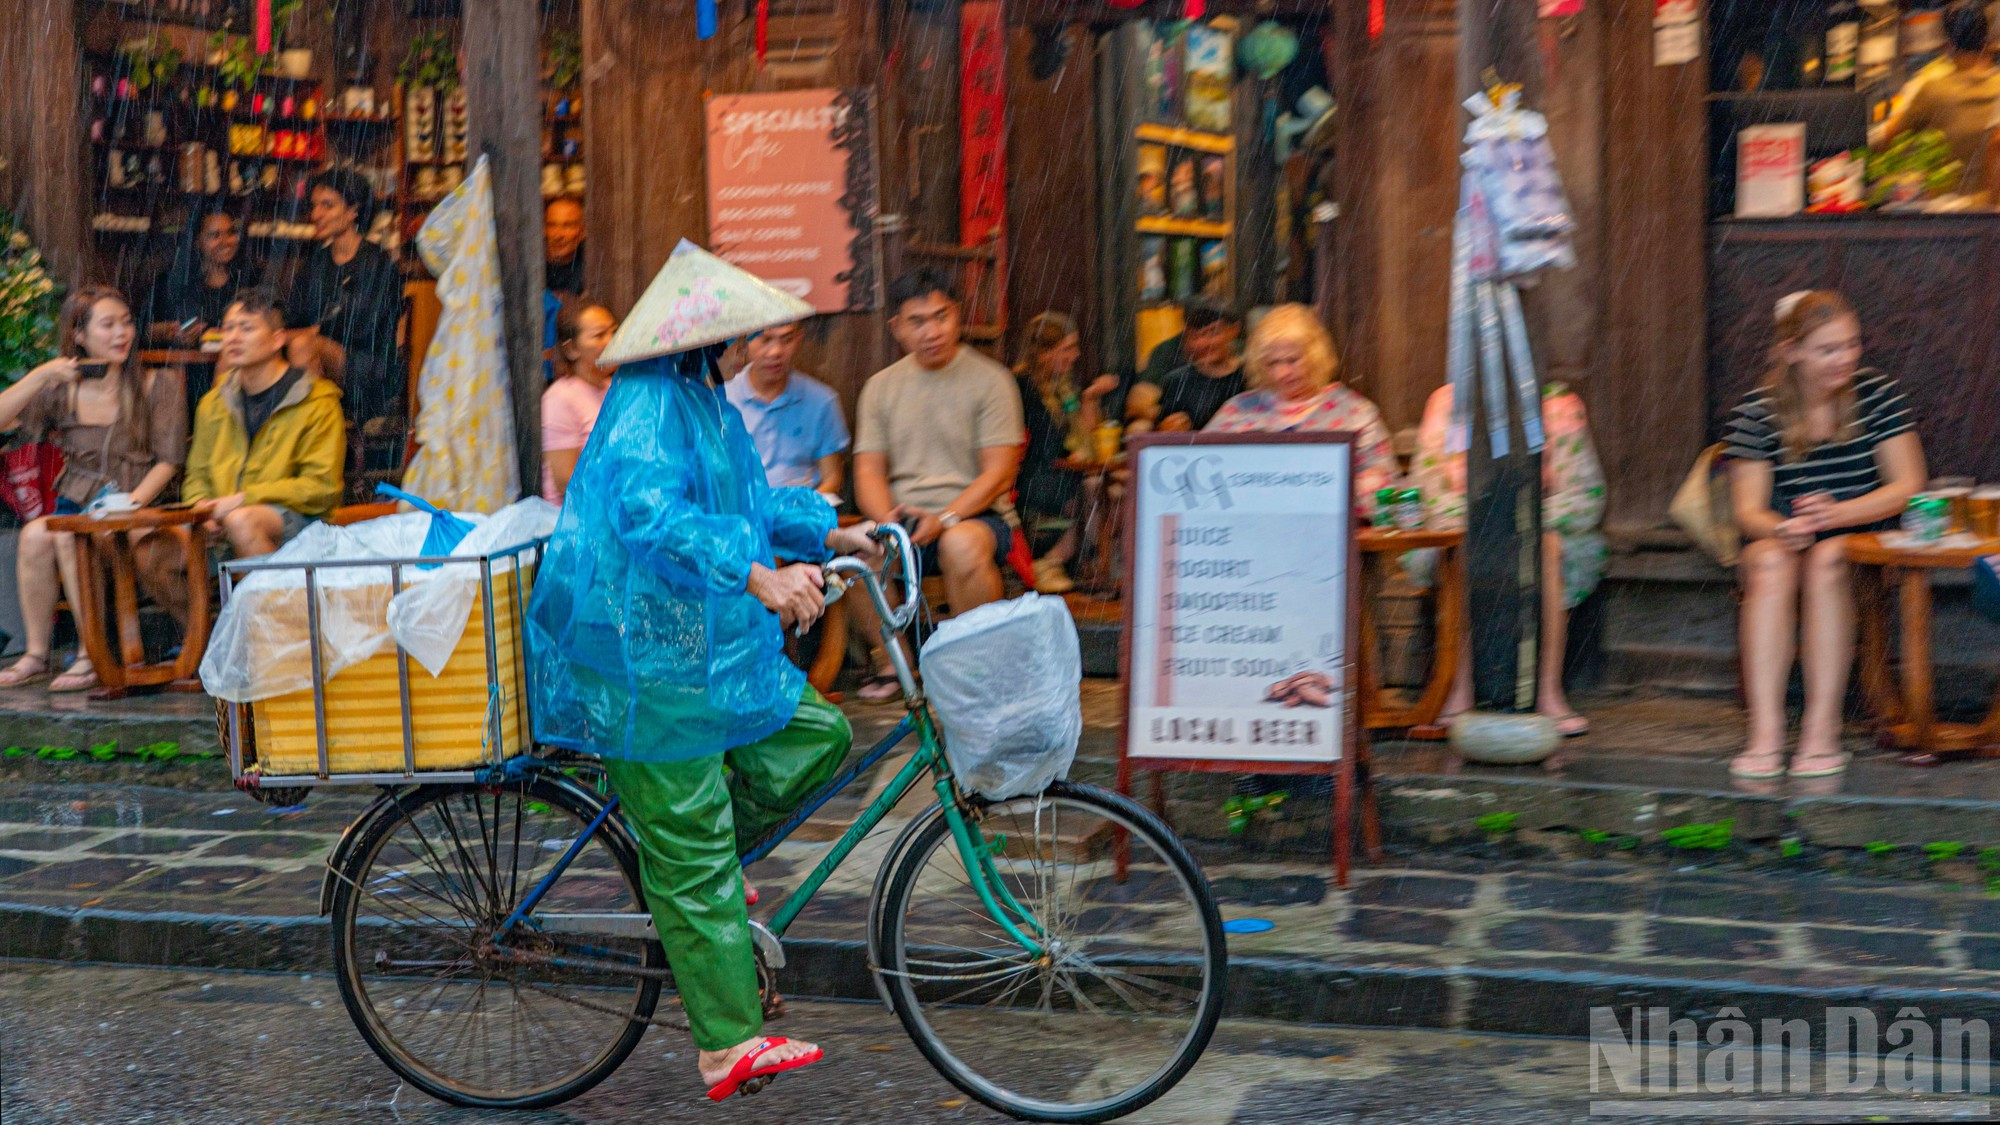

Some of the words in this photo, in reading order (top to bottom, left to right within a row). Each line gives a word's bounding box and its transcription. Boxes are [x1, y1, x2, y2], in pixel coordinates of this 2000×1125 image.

[722, 105, 851, 134] SPECIALTY
[783, 181, 833, 196] COFFEE
[1168, 526, 1233, 546] JUICE
[1163, 559, 1254, 578] YOGURT
[1162, 592, 1278, 611] SMOOTHIE
[1160, 625, 1199, 643] ICE
[1203, 625, 1283, 643] CREAM
[1160, 658, 1229, 676] FRUIT
[1230, 658, 1290, 677] SODA
[1151, 717, 1238, 744] LOCAL
[1249, 718, 1320, 745] BEER
